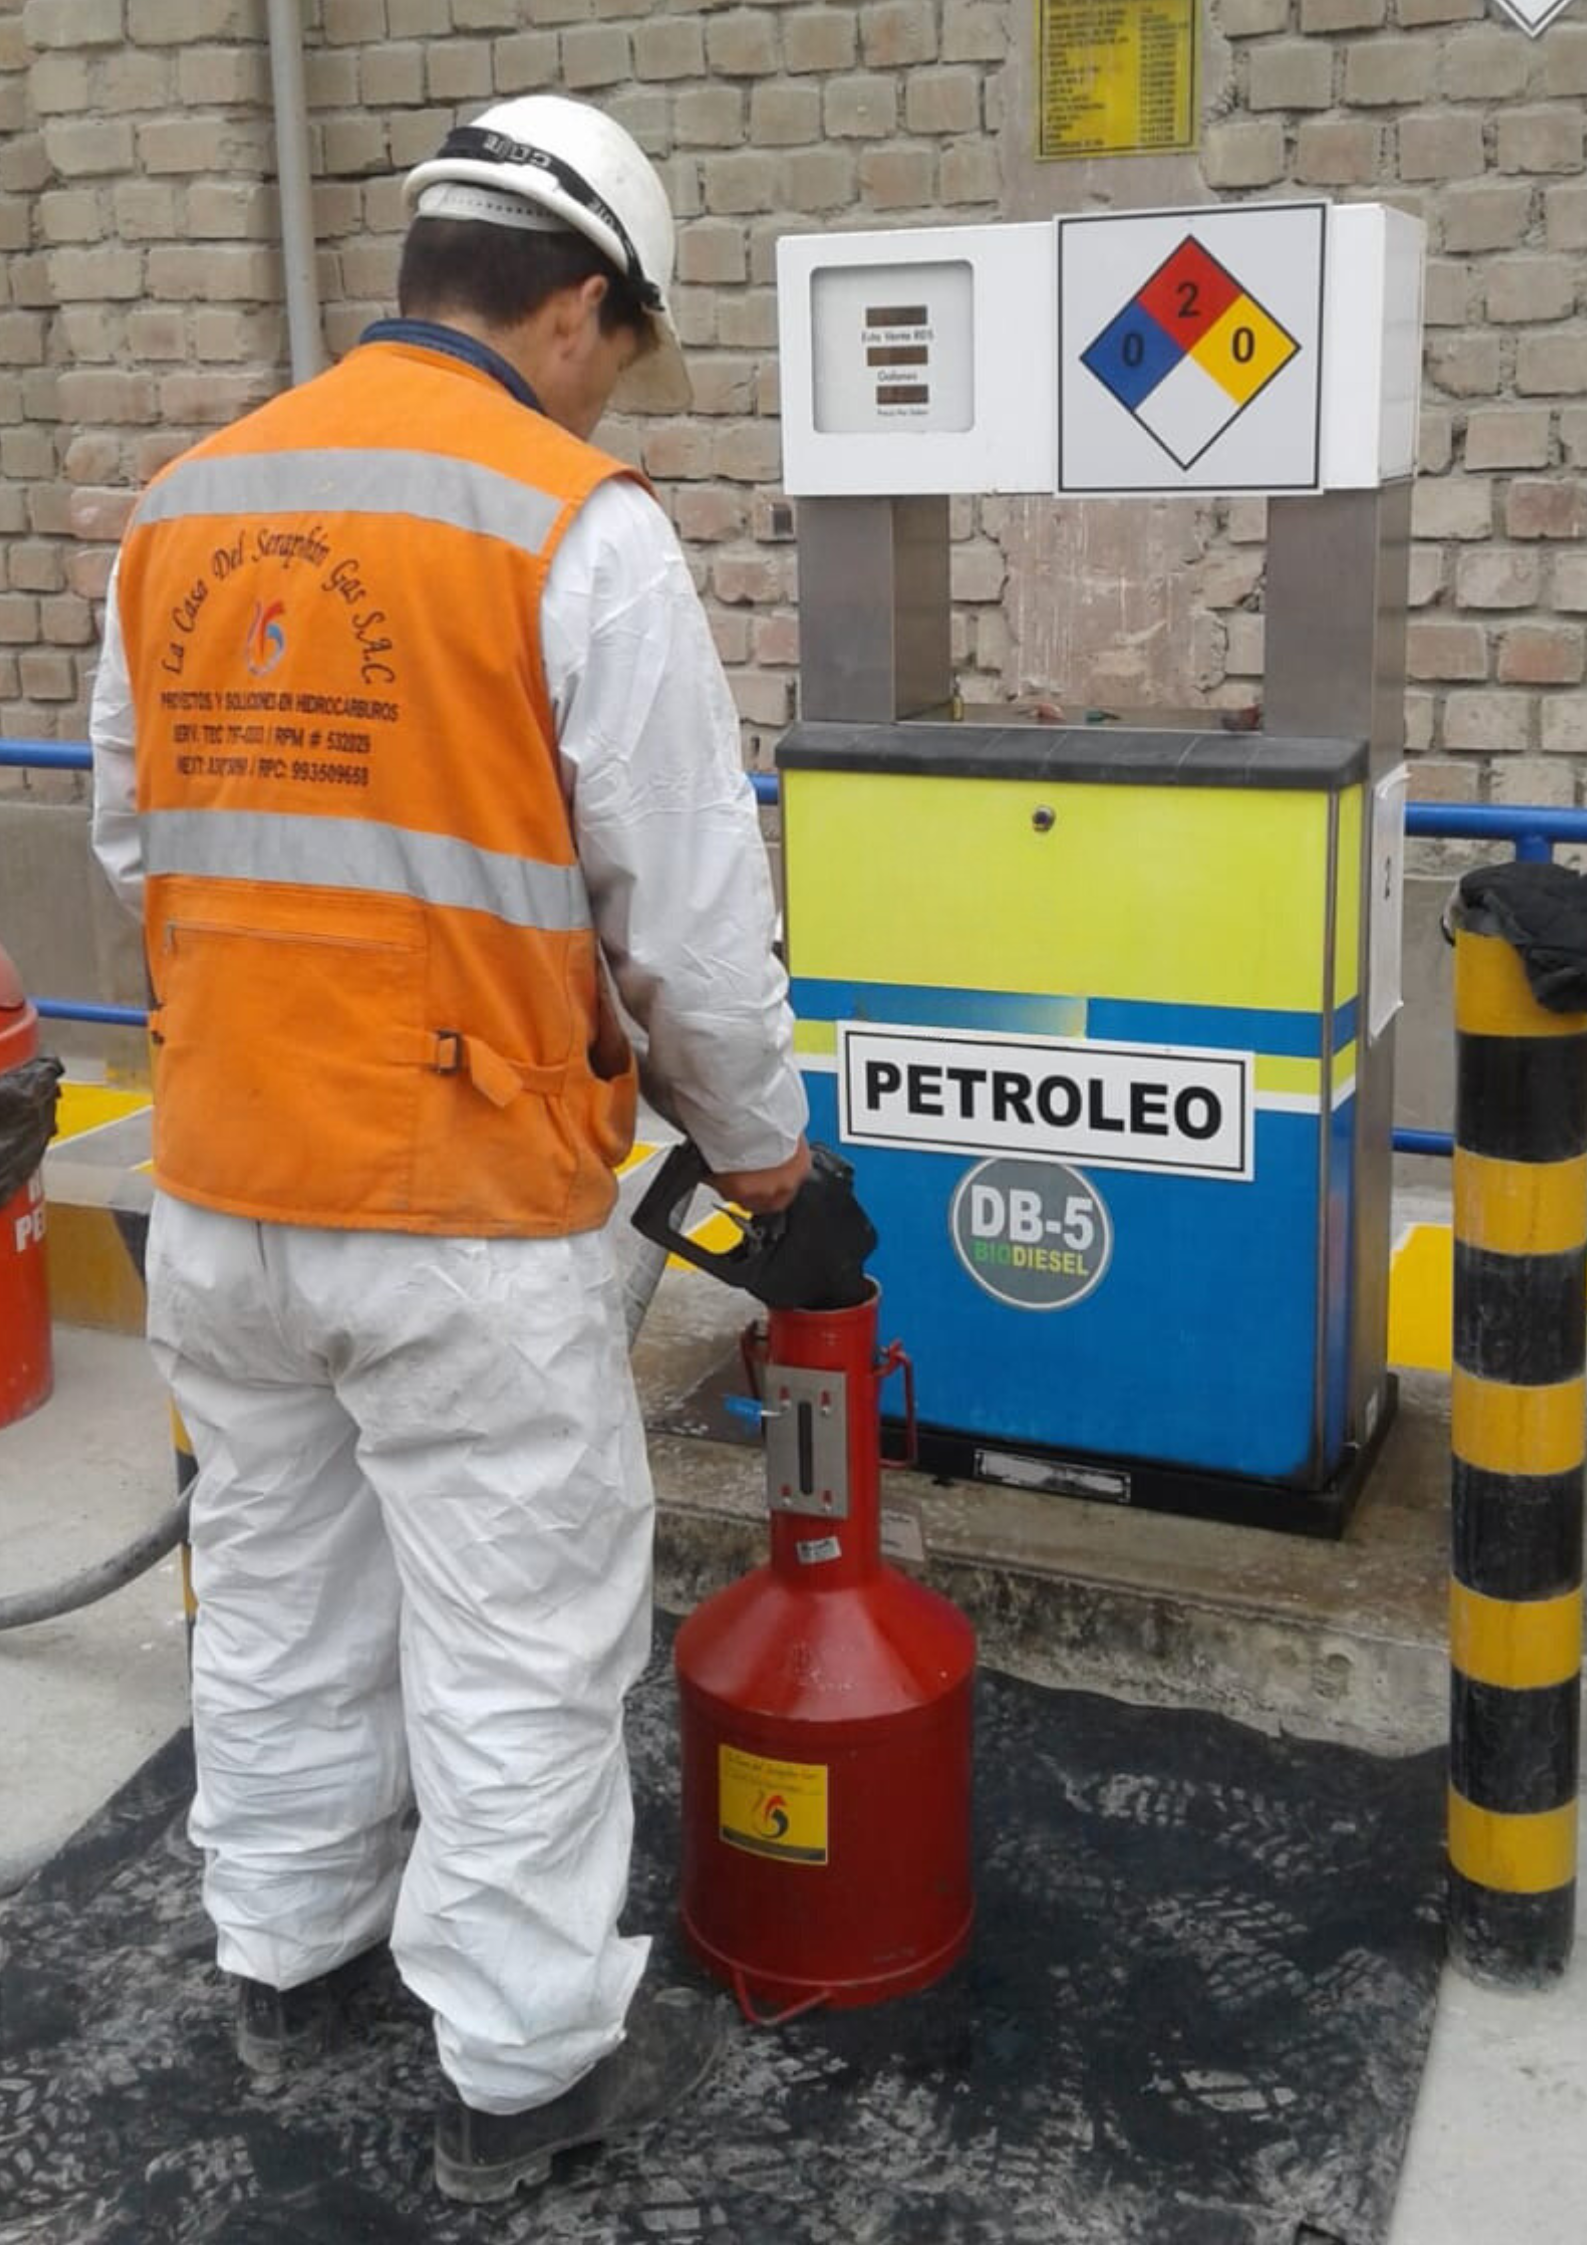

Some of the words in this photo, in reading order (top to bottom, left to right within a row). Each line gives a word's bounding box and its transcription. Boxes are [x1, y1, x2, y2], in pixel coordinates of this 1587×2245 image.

[1176, 281, 1200, 318] 2
[1122, 331, 1145, 368] 0
[1232, 327, 1256, 363] 0
[213, 530, 246, 580] Del
[321, 559, 367, 604] Gas
[172, 578, 208, 632] Casa
[161, 642, 184, 675] La
[865, 1060, 1223, 1140] PETROLEO
[970, 1184, 1094, 1251] DB-5
[974, 1240, 1089, 1276] BIODIESEL
